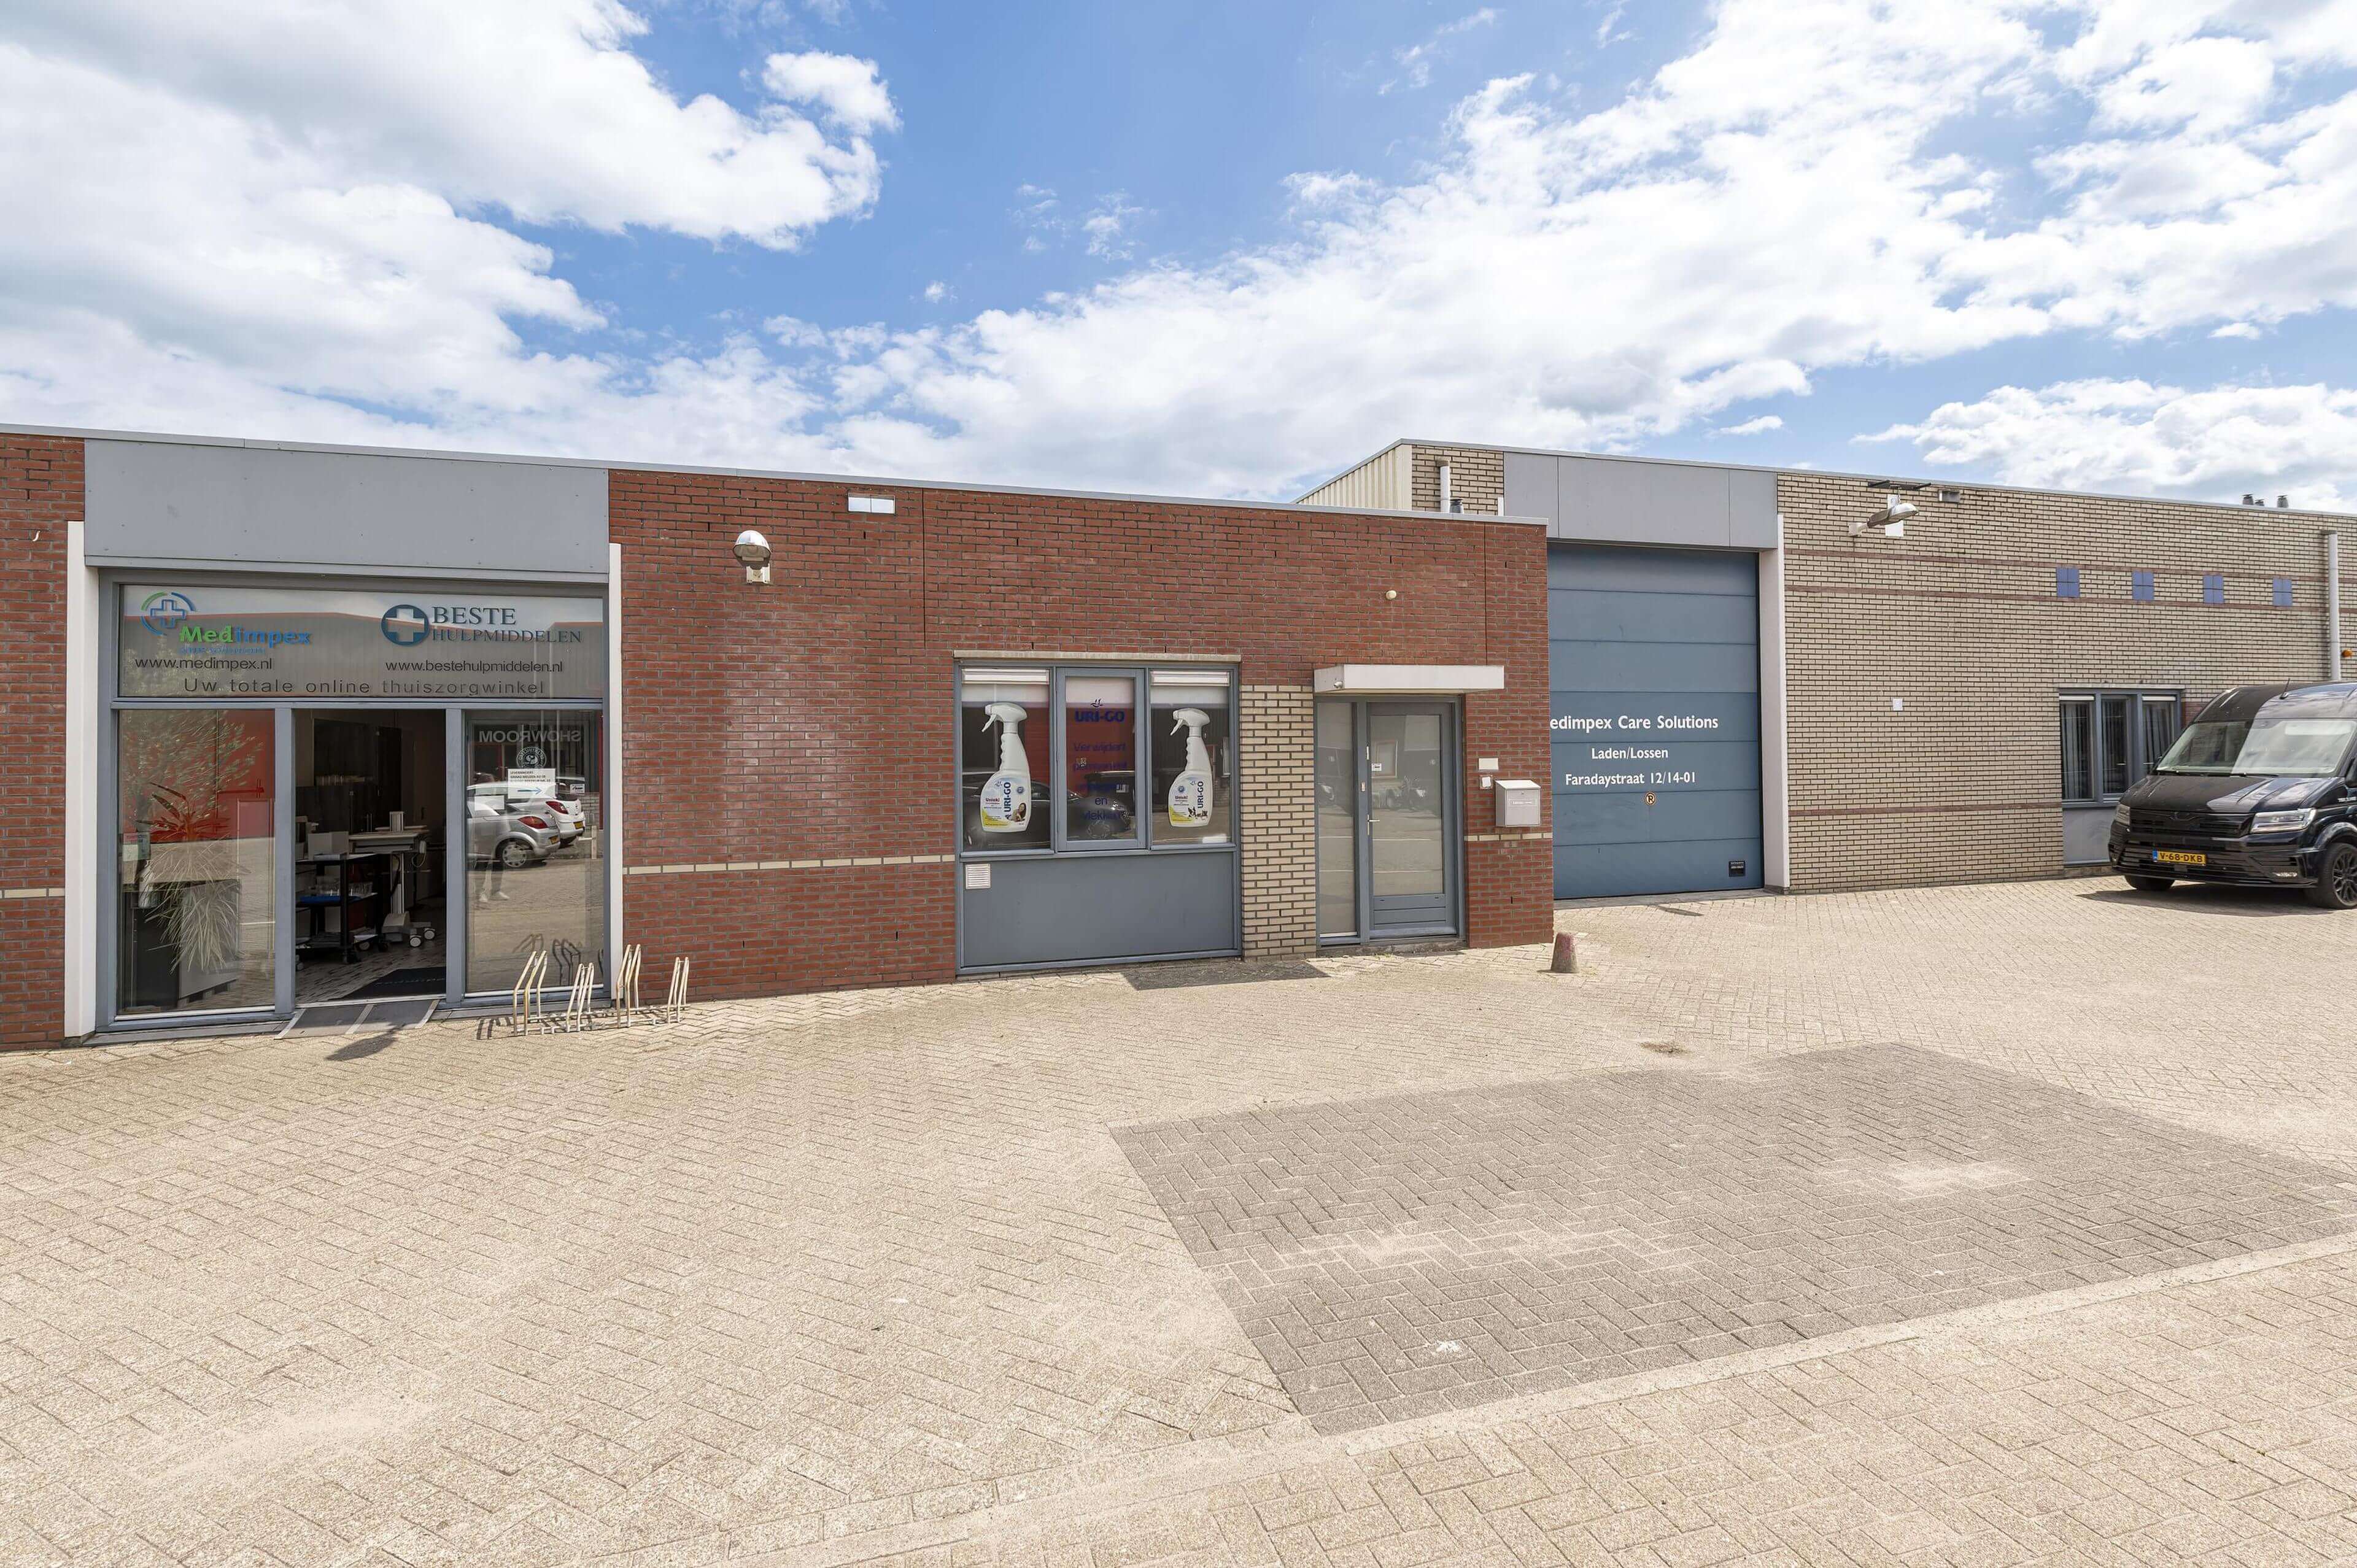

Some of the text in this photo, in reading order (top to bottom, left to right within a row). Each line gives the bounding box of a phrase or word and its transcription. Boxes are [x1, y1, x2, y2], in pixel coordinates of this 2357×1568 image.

[432, 606, 516, 625] BESTE
[179, 625, 311, 648] Medimpex
[433, 629, 582, 643] HULPMIDDELEN
[135, 657, 272, 671] www.medimpex.nl
[385, 660, 563, 674] www.bestehulpmiddelen.nl
[184, 678, 544, 696] Uw totale online thuiszorgwinkel
[1075, 710, 1125, 722] URI-GO
[1550, 716, 1719, 733] edimpex Care Solutions
[1591, 747, 1668, 759] Laden/Lossen
[1565, 771, 1695, 787] Faradaystraat 12/14-01
[2160, 852, 2203, 862] V-68-DKB
